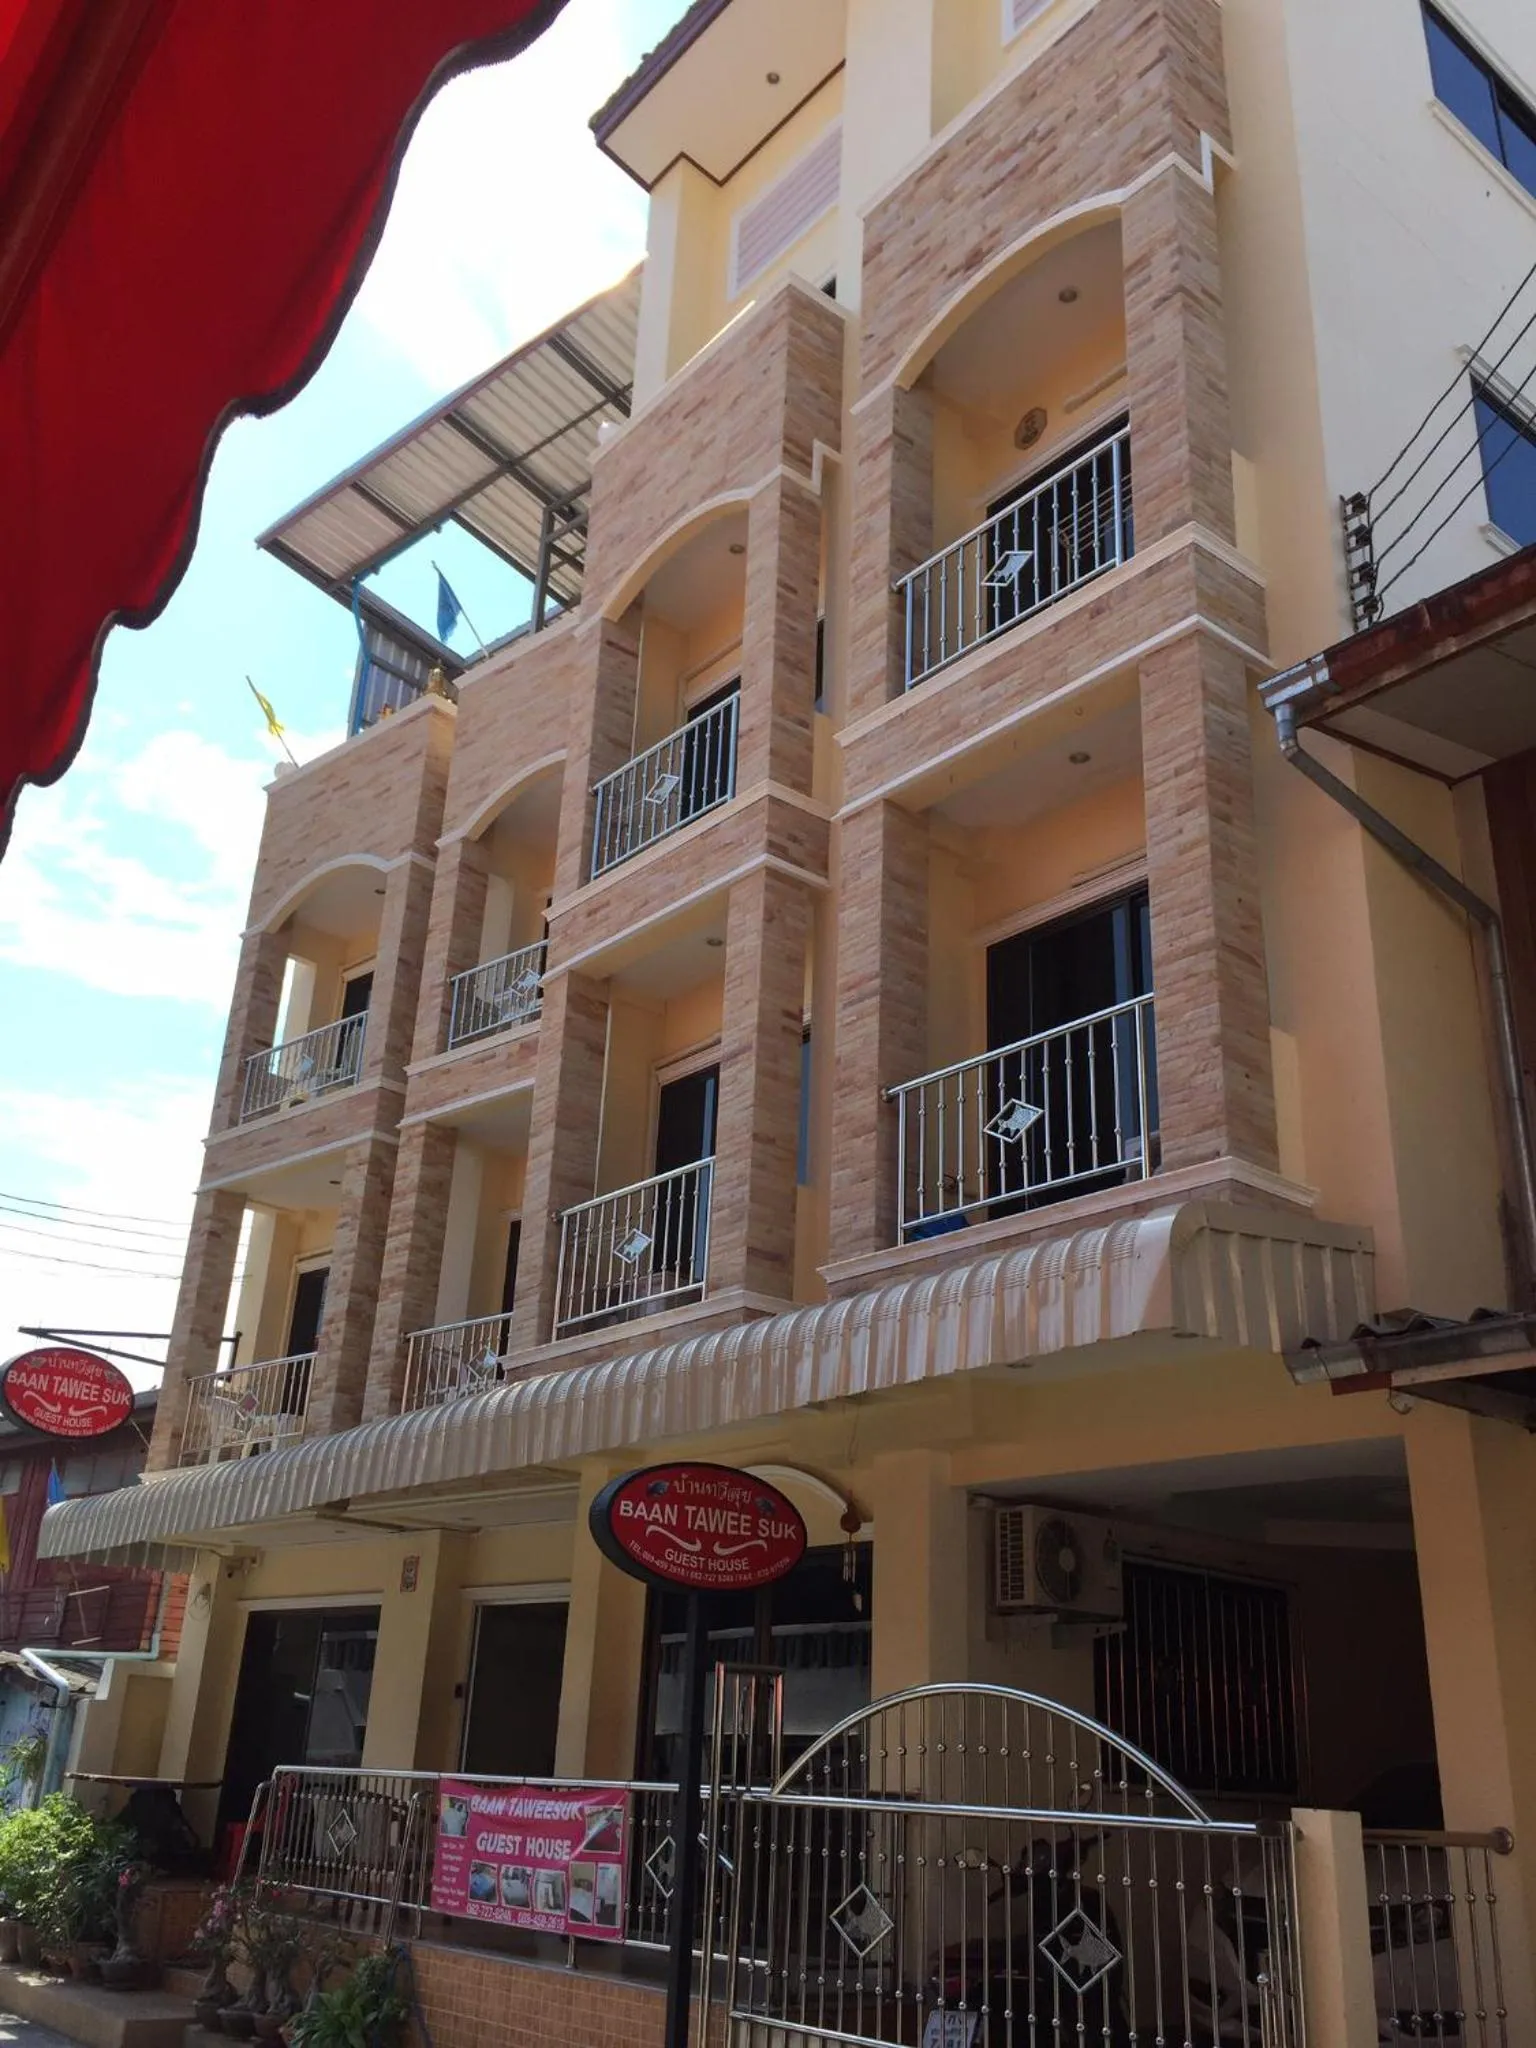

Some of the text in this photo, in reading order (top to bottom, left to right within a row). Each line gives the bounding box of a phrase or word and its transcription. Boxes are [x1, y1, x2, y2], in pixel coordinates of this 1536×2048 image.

[7, 1370, 131, 1406] BAAN TAWEE SUK
[33, 1407, 62, 1425] GUEST
[63, 1416, 93, 1428] HOUSE
[619, 1499, 797, 1541] BAAN TAWEE SUK
[664, 1548, 750, 1573] GUEST HOUSE
[470, 1794, 584, 1821] BAAN TAWEESUK
[476, 1831, 572, 1860] GUEST HOUSE
